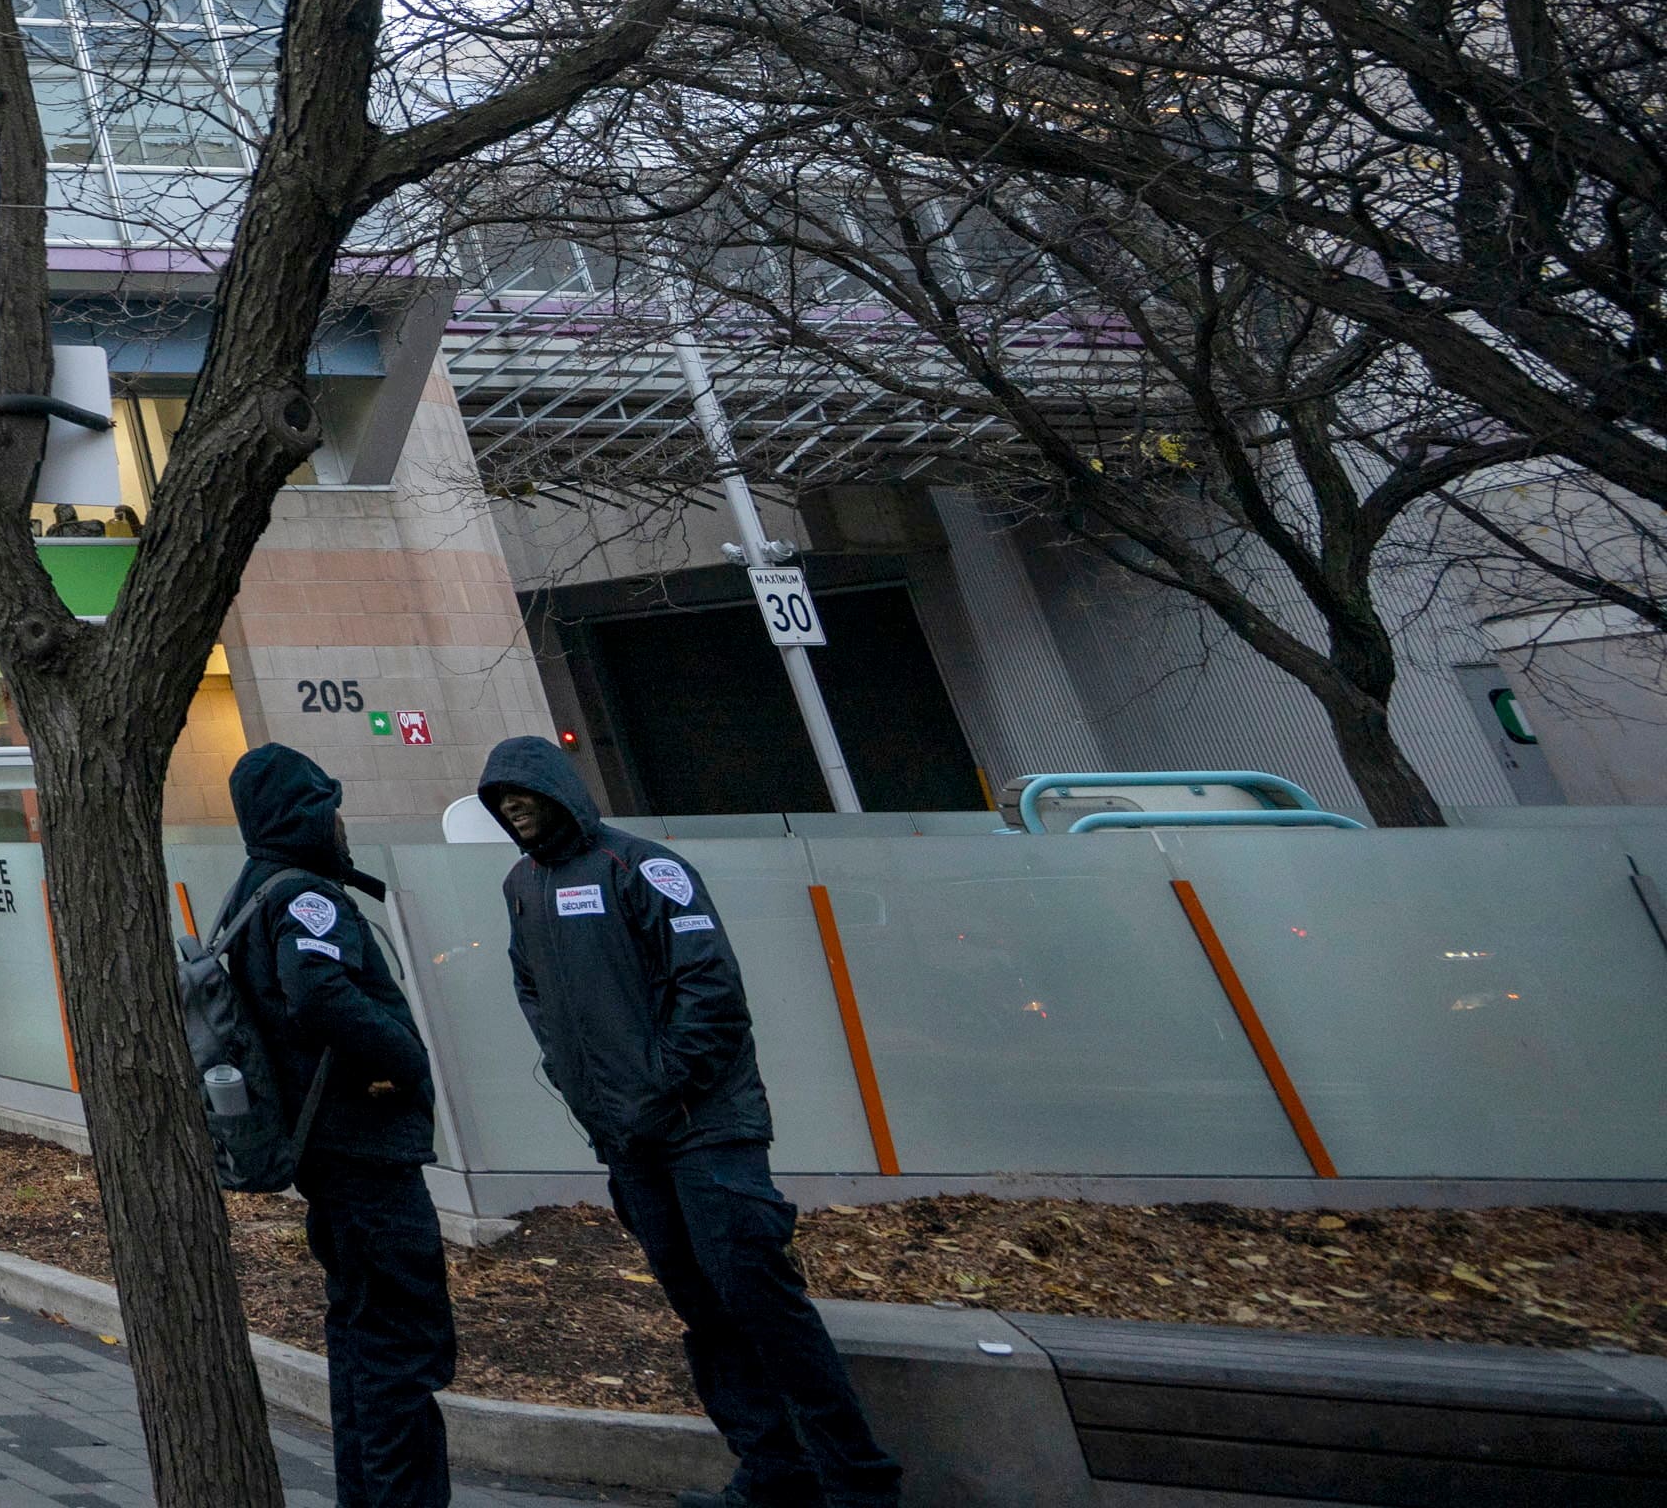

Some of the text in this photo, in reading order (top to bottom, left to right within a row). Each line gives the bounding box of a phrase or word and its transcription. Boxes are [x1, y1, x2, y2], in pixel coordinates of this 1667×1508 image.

[755, 574, 799, 584] MAXIMUM
[766, 593, 811, 632] 30
[297, 680, 364, 713] 205
[562, 899, 598, 910] SÉCURITÉ
